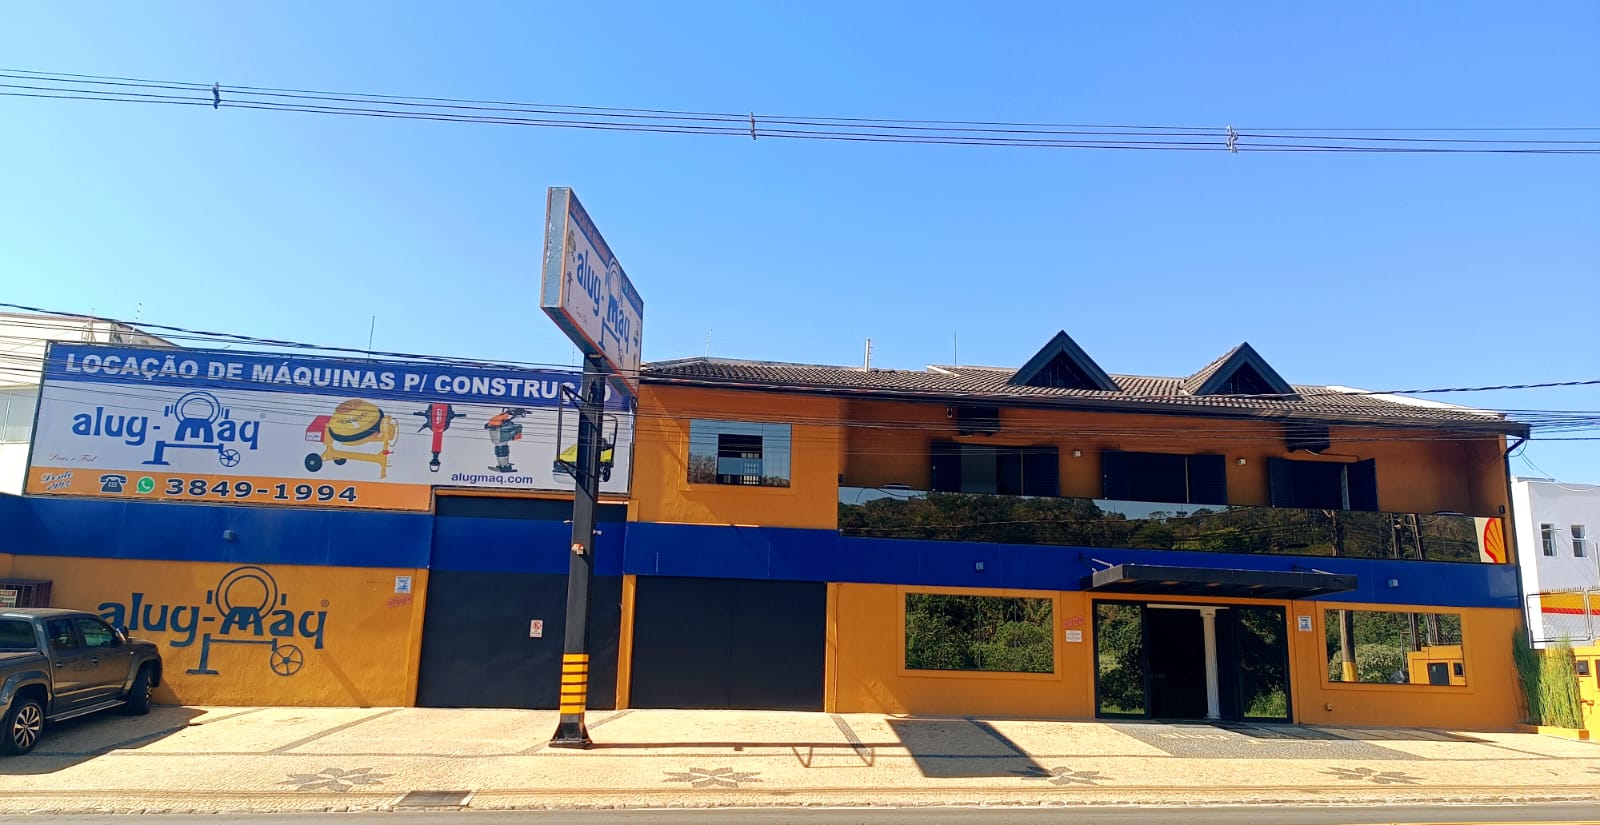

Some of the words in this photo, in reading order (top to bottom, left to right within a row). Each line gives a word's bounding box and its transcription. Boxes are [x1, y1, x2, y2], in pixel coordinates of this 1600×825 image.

[65, 353, 199, 380] LOCAÇÃO
[207, 361, 242, 381] DE
[251, 362, 395, 391] MÁQUINAS
[403, 373, 428, 393] P/
[165, 478, 358, 503] 3849-1994
[451, 472, 533, 485] alugmaq.com
